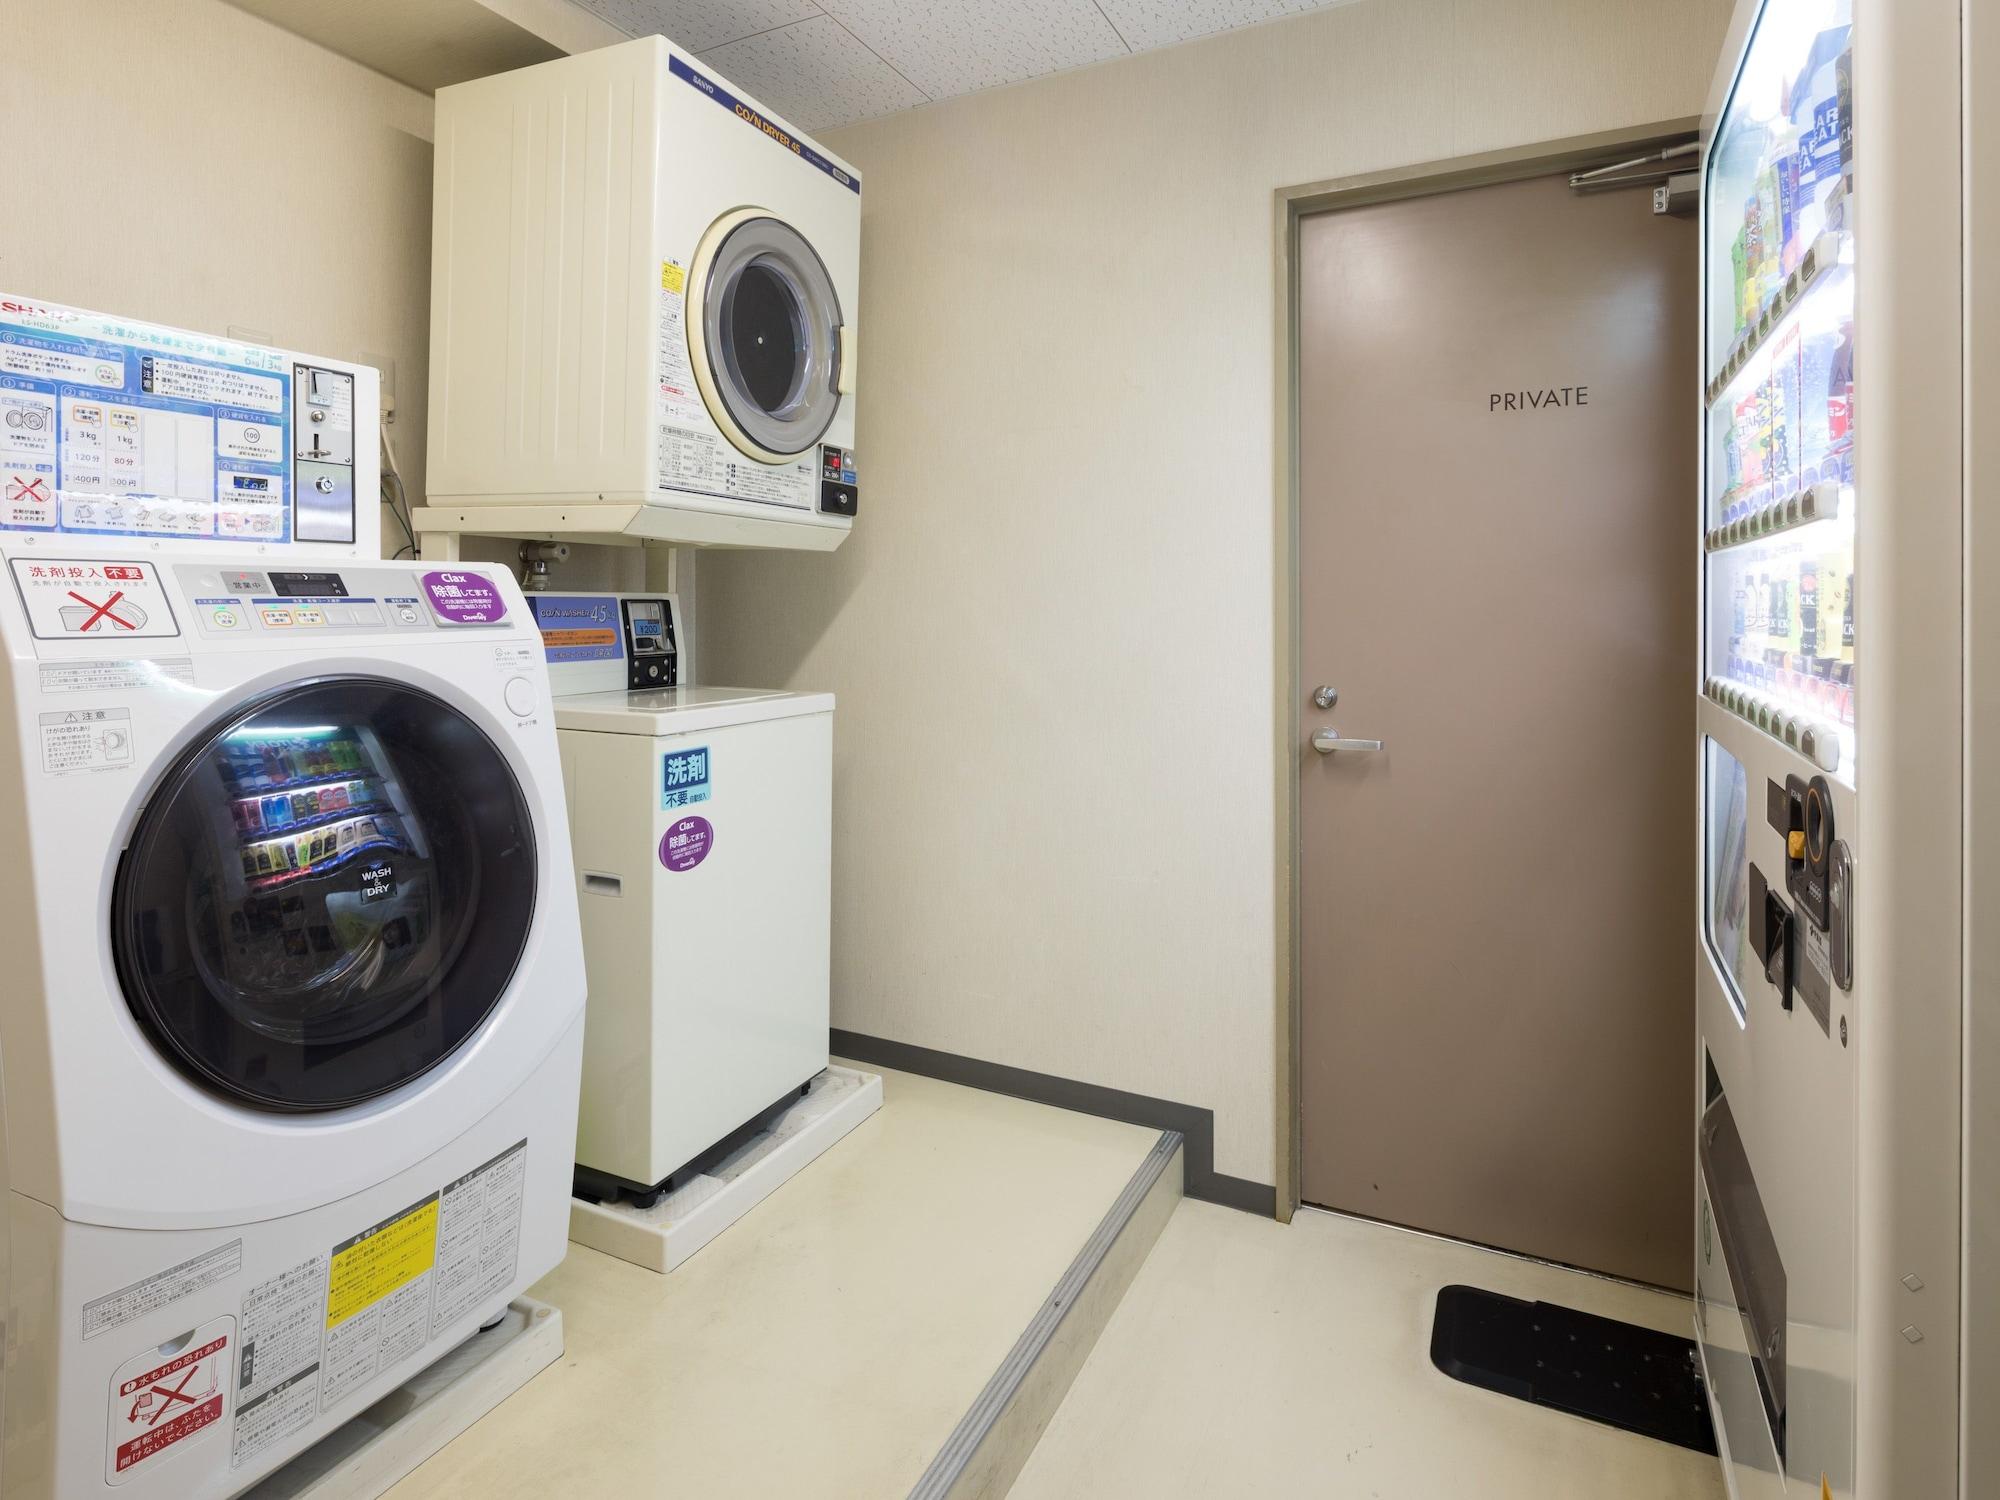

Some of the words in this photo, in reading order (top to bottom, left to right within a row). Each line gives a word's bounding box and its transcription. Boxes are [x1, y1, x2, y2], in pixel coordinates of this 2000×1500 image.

[693, 75, 714, 94] SANYO
[762, 121, 790, 147] DRYER
[1490, 386, 1588, 412] PRIVATE
[29, 566, 103, 578] 洗剤投入
[107, 567, 142, 579] 不要
[441, 573, 467, 583] Clax
[233, 581, 262, 590] 営業中
[430, 585, 493, 598] 除菌してます。
[590, 605, 607, 624] 45
[82, 710, 107, 721] 注意
[667, 752, 706, 786] 洗剤
[665, 789, 689, 809] 不要
[679, 821, 695, 832] Clax
[361, 867, 392, 881] WASH
[367, 884, 390, 897] DRY
[374, 878, 382, 887] &
[138, 1339, 224, 1387] 水もれの恐れあり
[130, 1404, 212, 1452] 運転中は、ふたを
[120, 1412, 219, 1469] 開けないでください。
